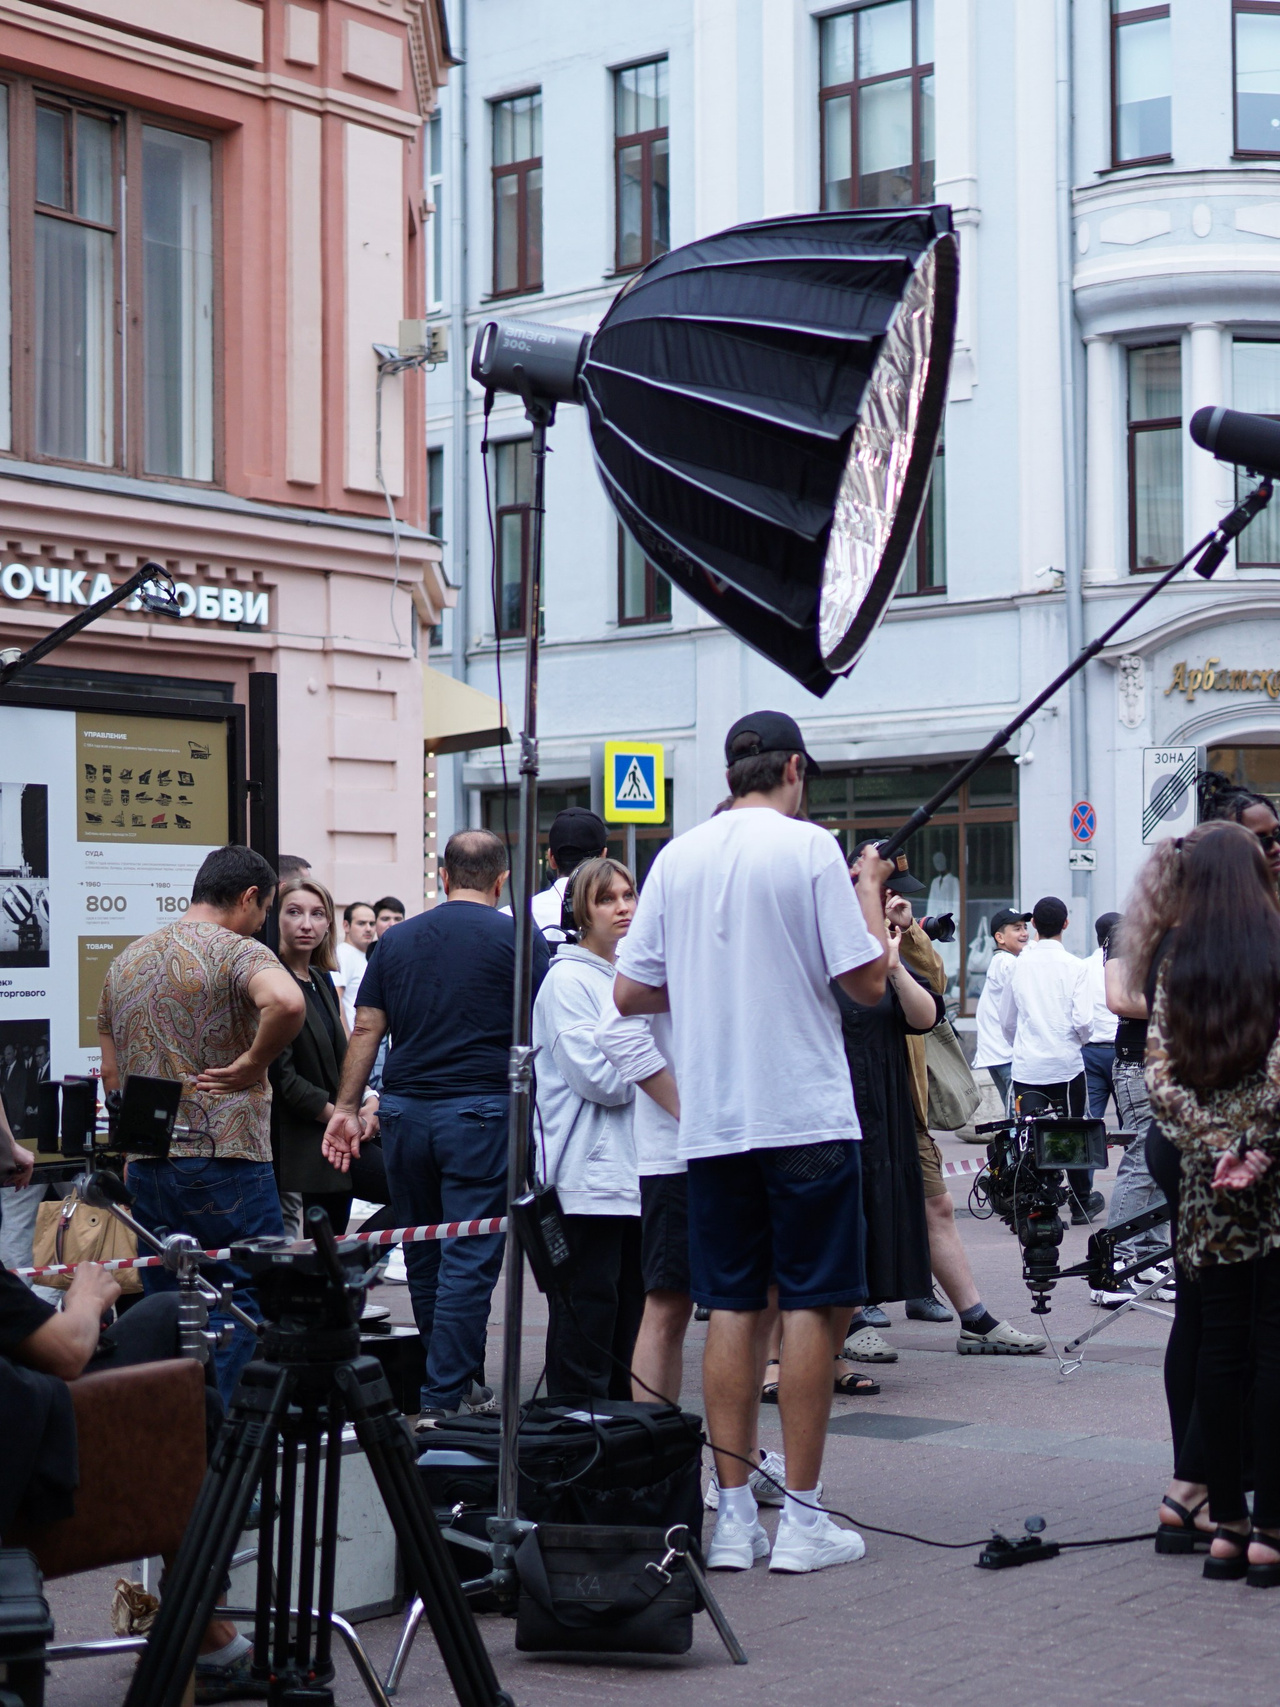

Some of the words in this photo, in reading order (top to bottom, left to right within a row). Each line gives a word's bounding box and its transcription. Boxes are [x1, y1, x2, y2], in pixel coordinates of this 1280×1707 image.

[504, 326, 557, 345] amaran
[0, 562, 118, 609] ОЧКА
[83, 731, 128, 740] УПРАВЛЕНИЕ
[1154, 752, 1185, 765] ЗОНА
[86, 895, 127, 912] 800
[0, 990, 46, 999] торгового
